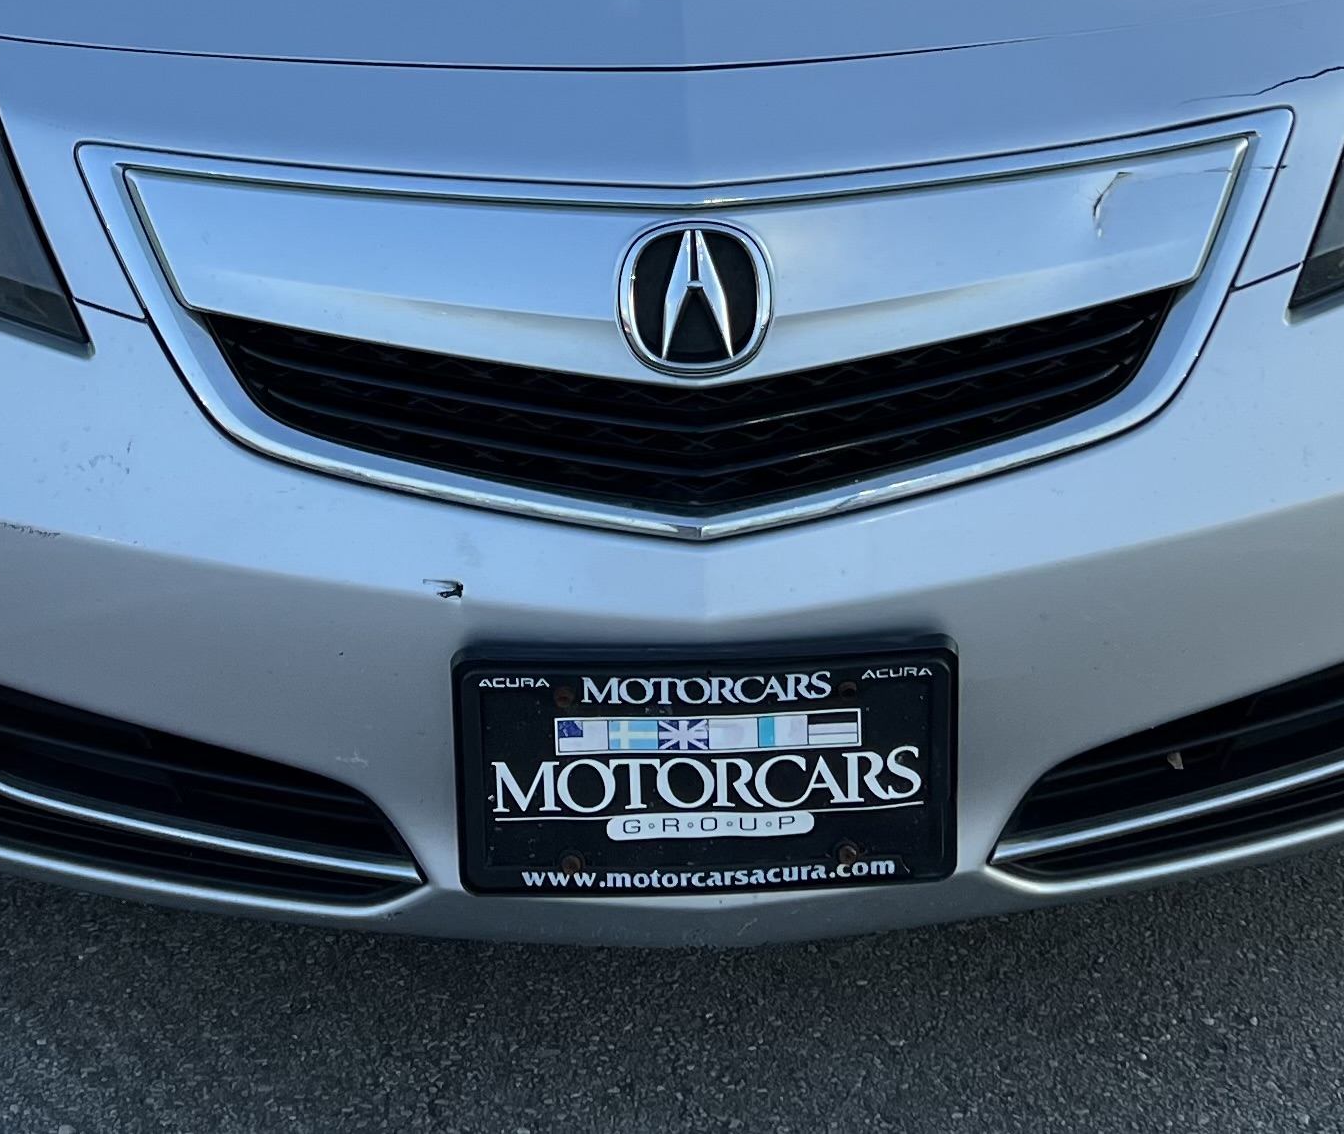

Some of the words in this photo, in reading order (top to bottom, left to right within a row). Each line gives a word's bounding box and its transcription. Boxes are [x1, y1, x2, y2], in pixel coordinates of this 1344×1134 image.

[478, 677, 550, 689] ACURA
[581, 671, 832, 705] MOTORCARS
[861, 667, 933, 680] ACURA
[491, 745, 923, 813] MOTORCARS
[521, 858, 896, 888] www.motorcarsacura.com
